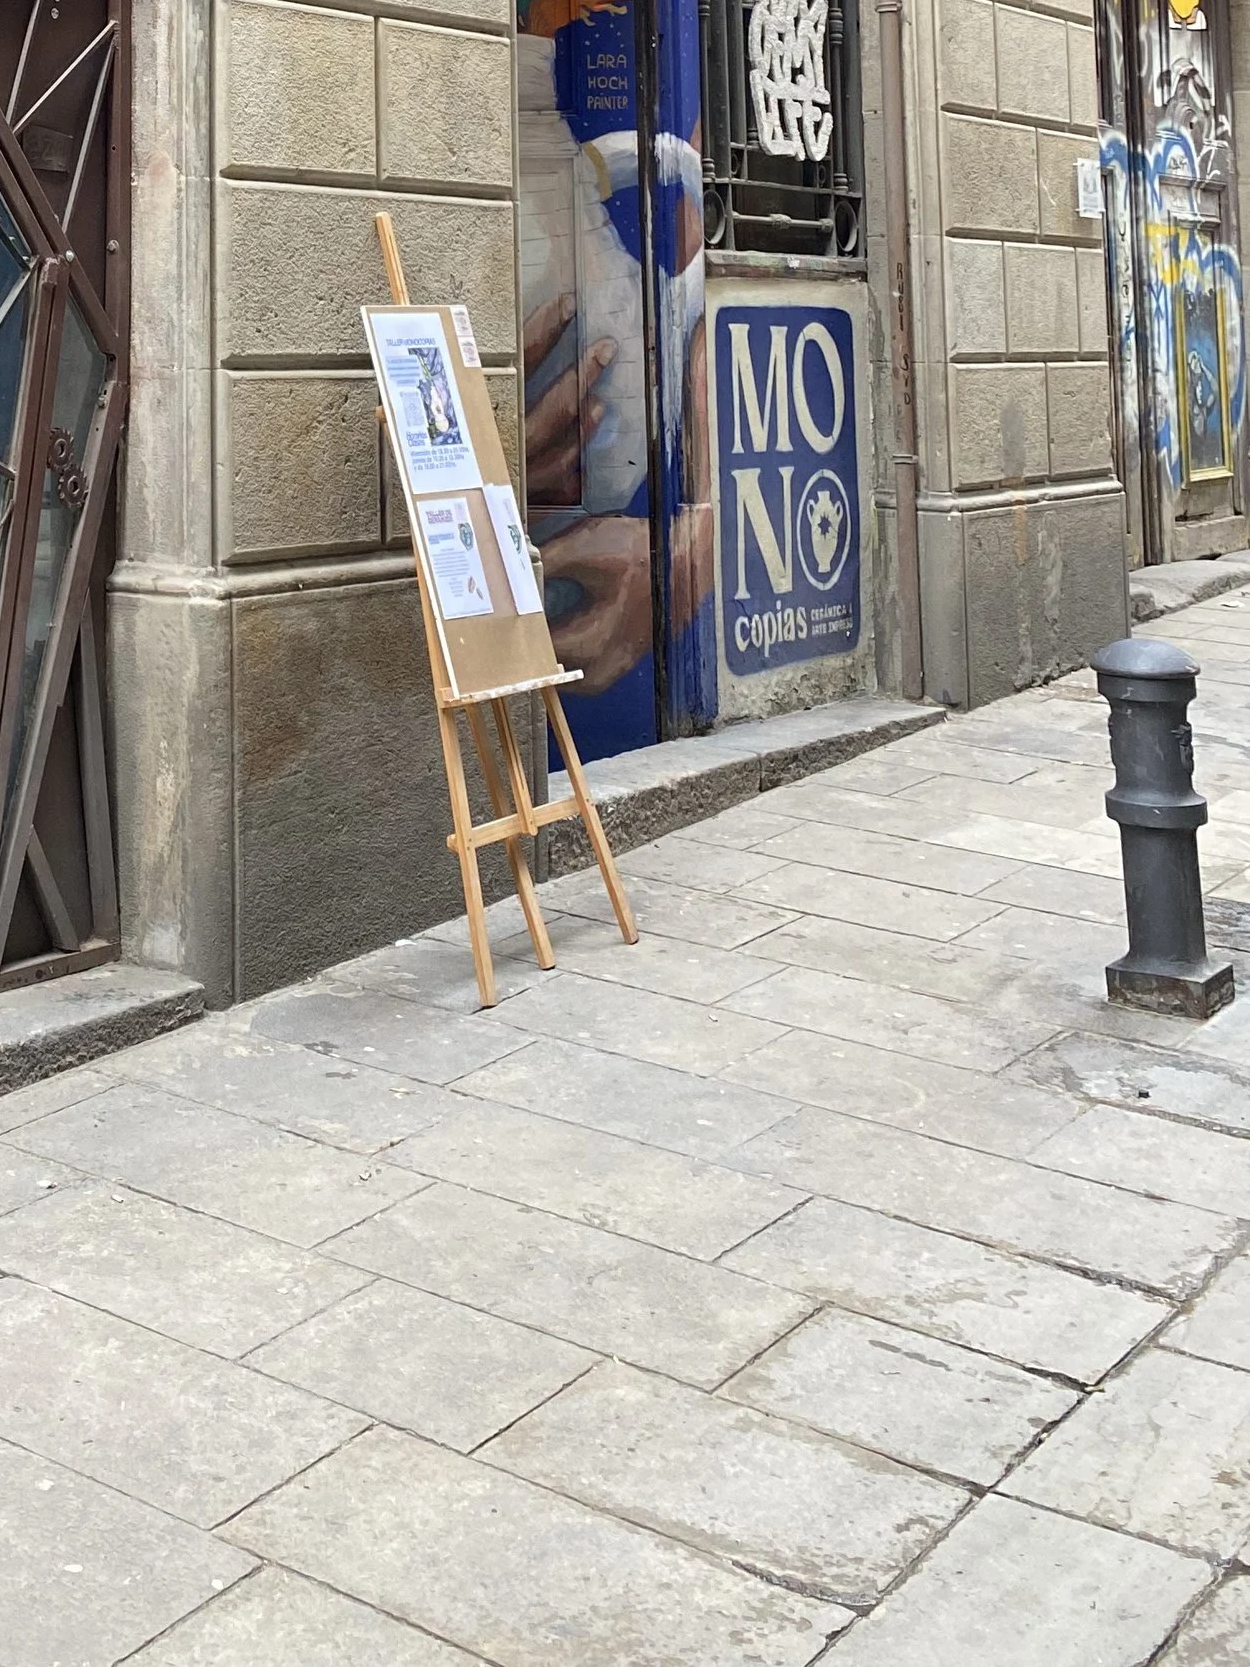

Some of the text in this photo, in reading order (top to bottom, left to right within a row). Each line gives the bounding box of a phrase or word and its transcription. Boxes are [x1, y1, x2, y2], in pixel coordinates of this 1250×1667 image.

[586, 53, 627, 69] LARA
[587, 75, 628, 90] HOCH
[586, 95, 629, 110] PAINTER
[728, 321, 845, 455] MO
[734, 600, 808, 658] copias
